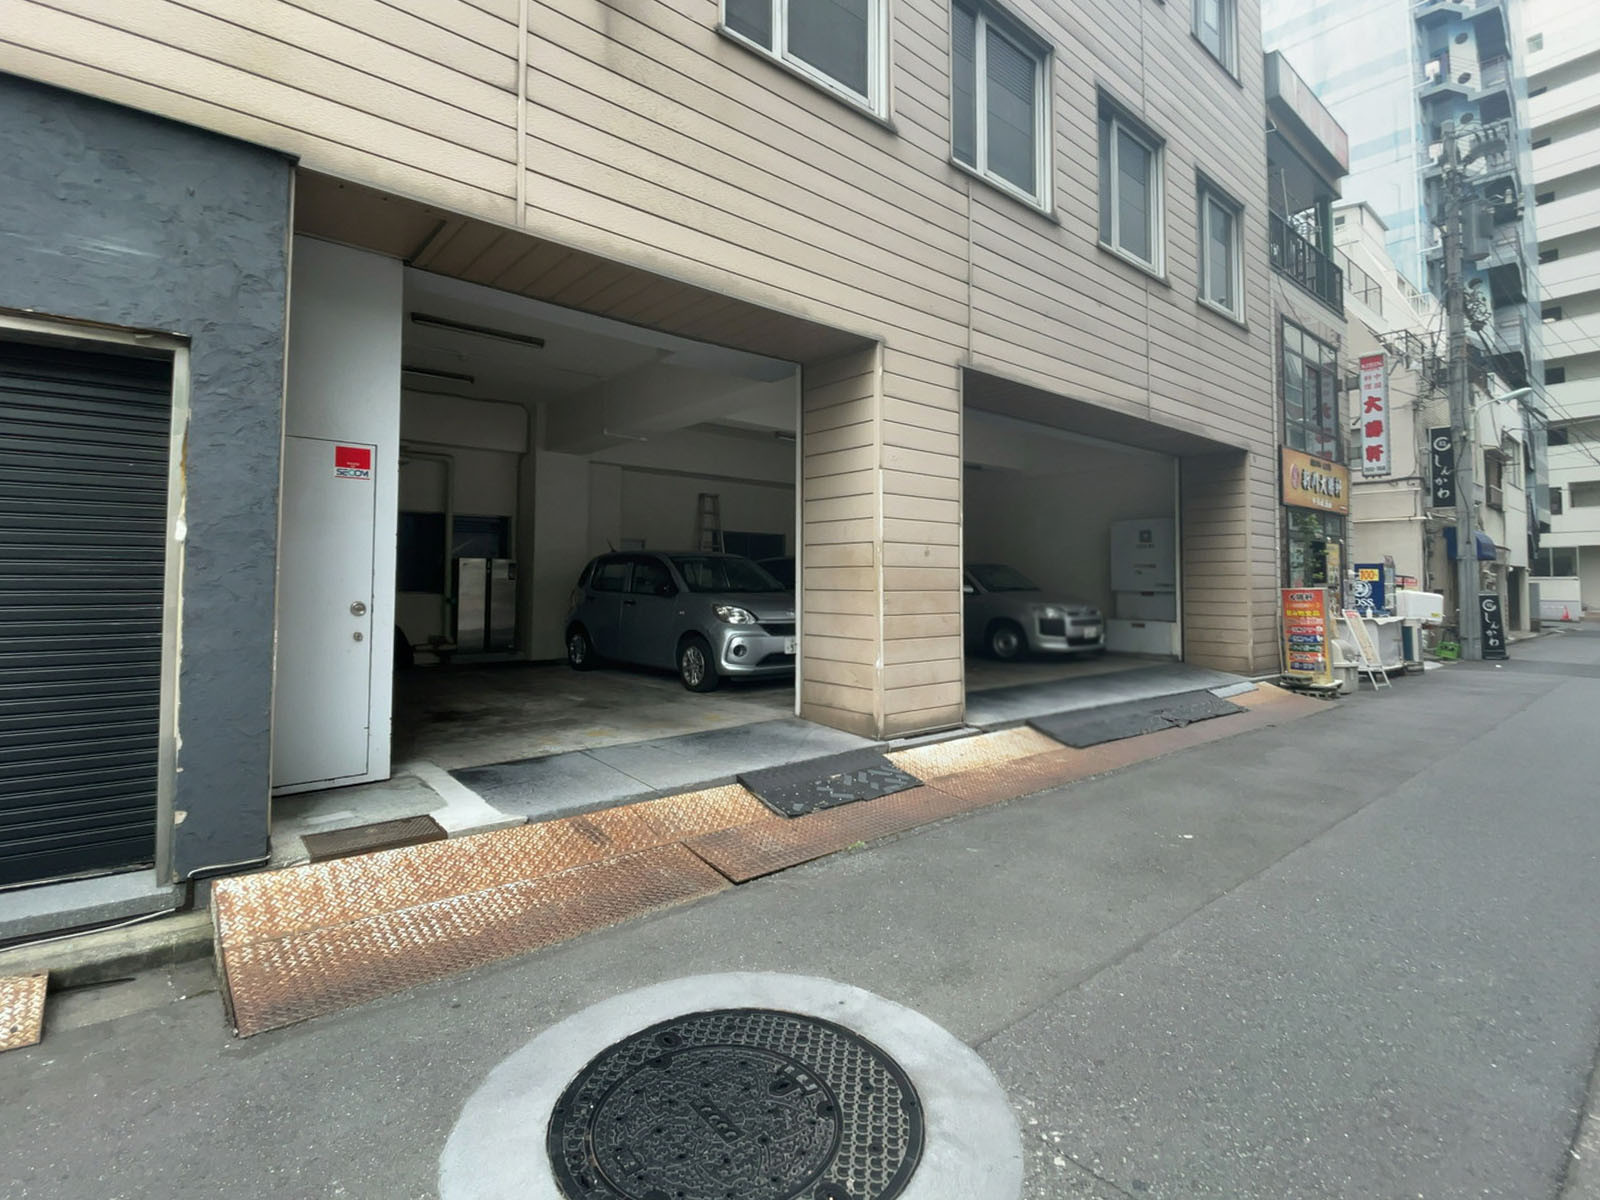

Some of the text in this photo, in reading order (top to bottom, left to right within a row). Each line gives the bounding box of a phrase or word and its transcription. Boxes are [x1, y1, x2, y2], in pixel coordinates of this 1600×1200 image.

[335, 468, 369, 477] SECOM
[1434, 453, 1451, 499] しんかわ
[1355, 598, 1376, 609] OSS
[1484, 611, 1500, 647] しんかわ
